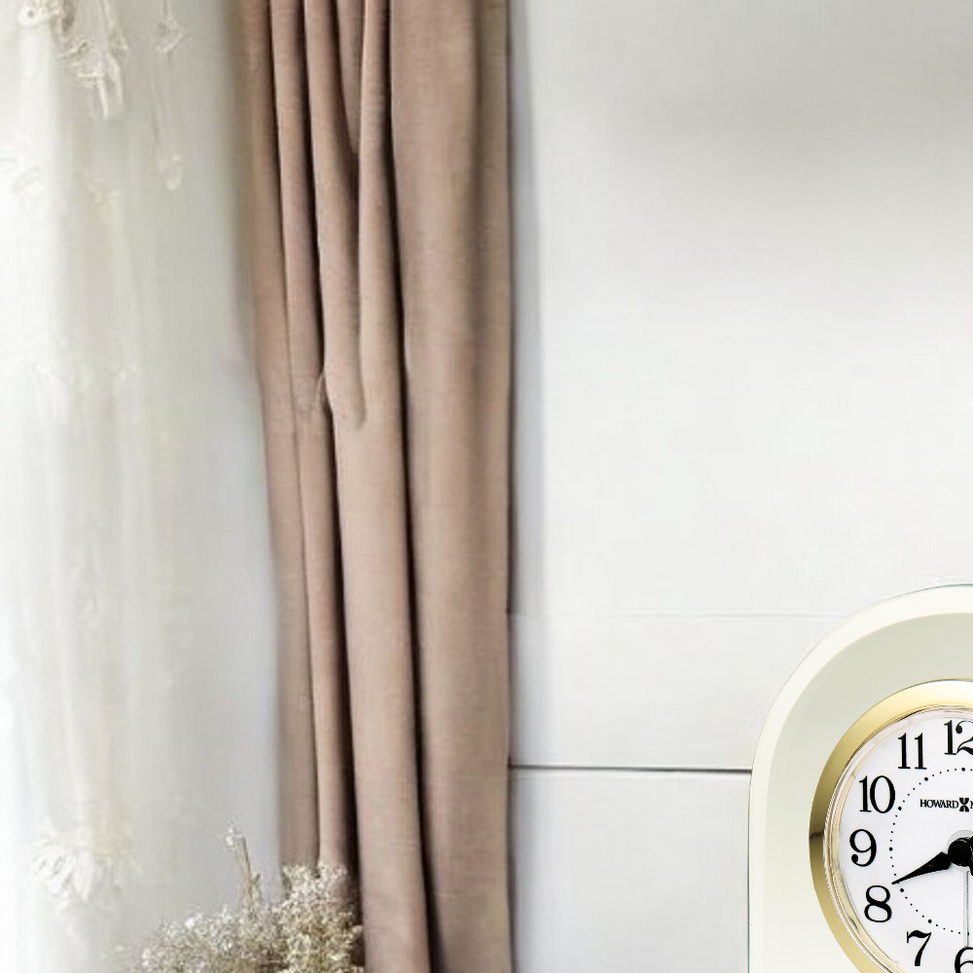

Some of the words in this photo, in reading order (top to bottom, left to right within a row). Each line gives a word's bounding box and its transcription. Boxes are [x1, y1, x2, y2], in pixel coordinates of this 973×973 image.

[897, 732, 928, 770] 11
[858, 775, 896, 814] 10
[919, 799, 960, 809] HOWARD
[848, 828, 878, 868] 9
[863, 884, 893, 924] 8
[906, 929, 932, 967] 7
